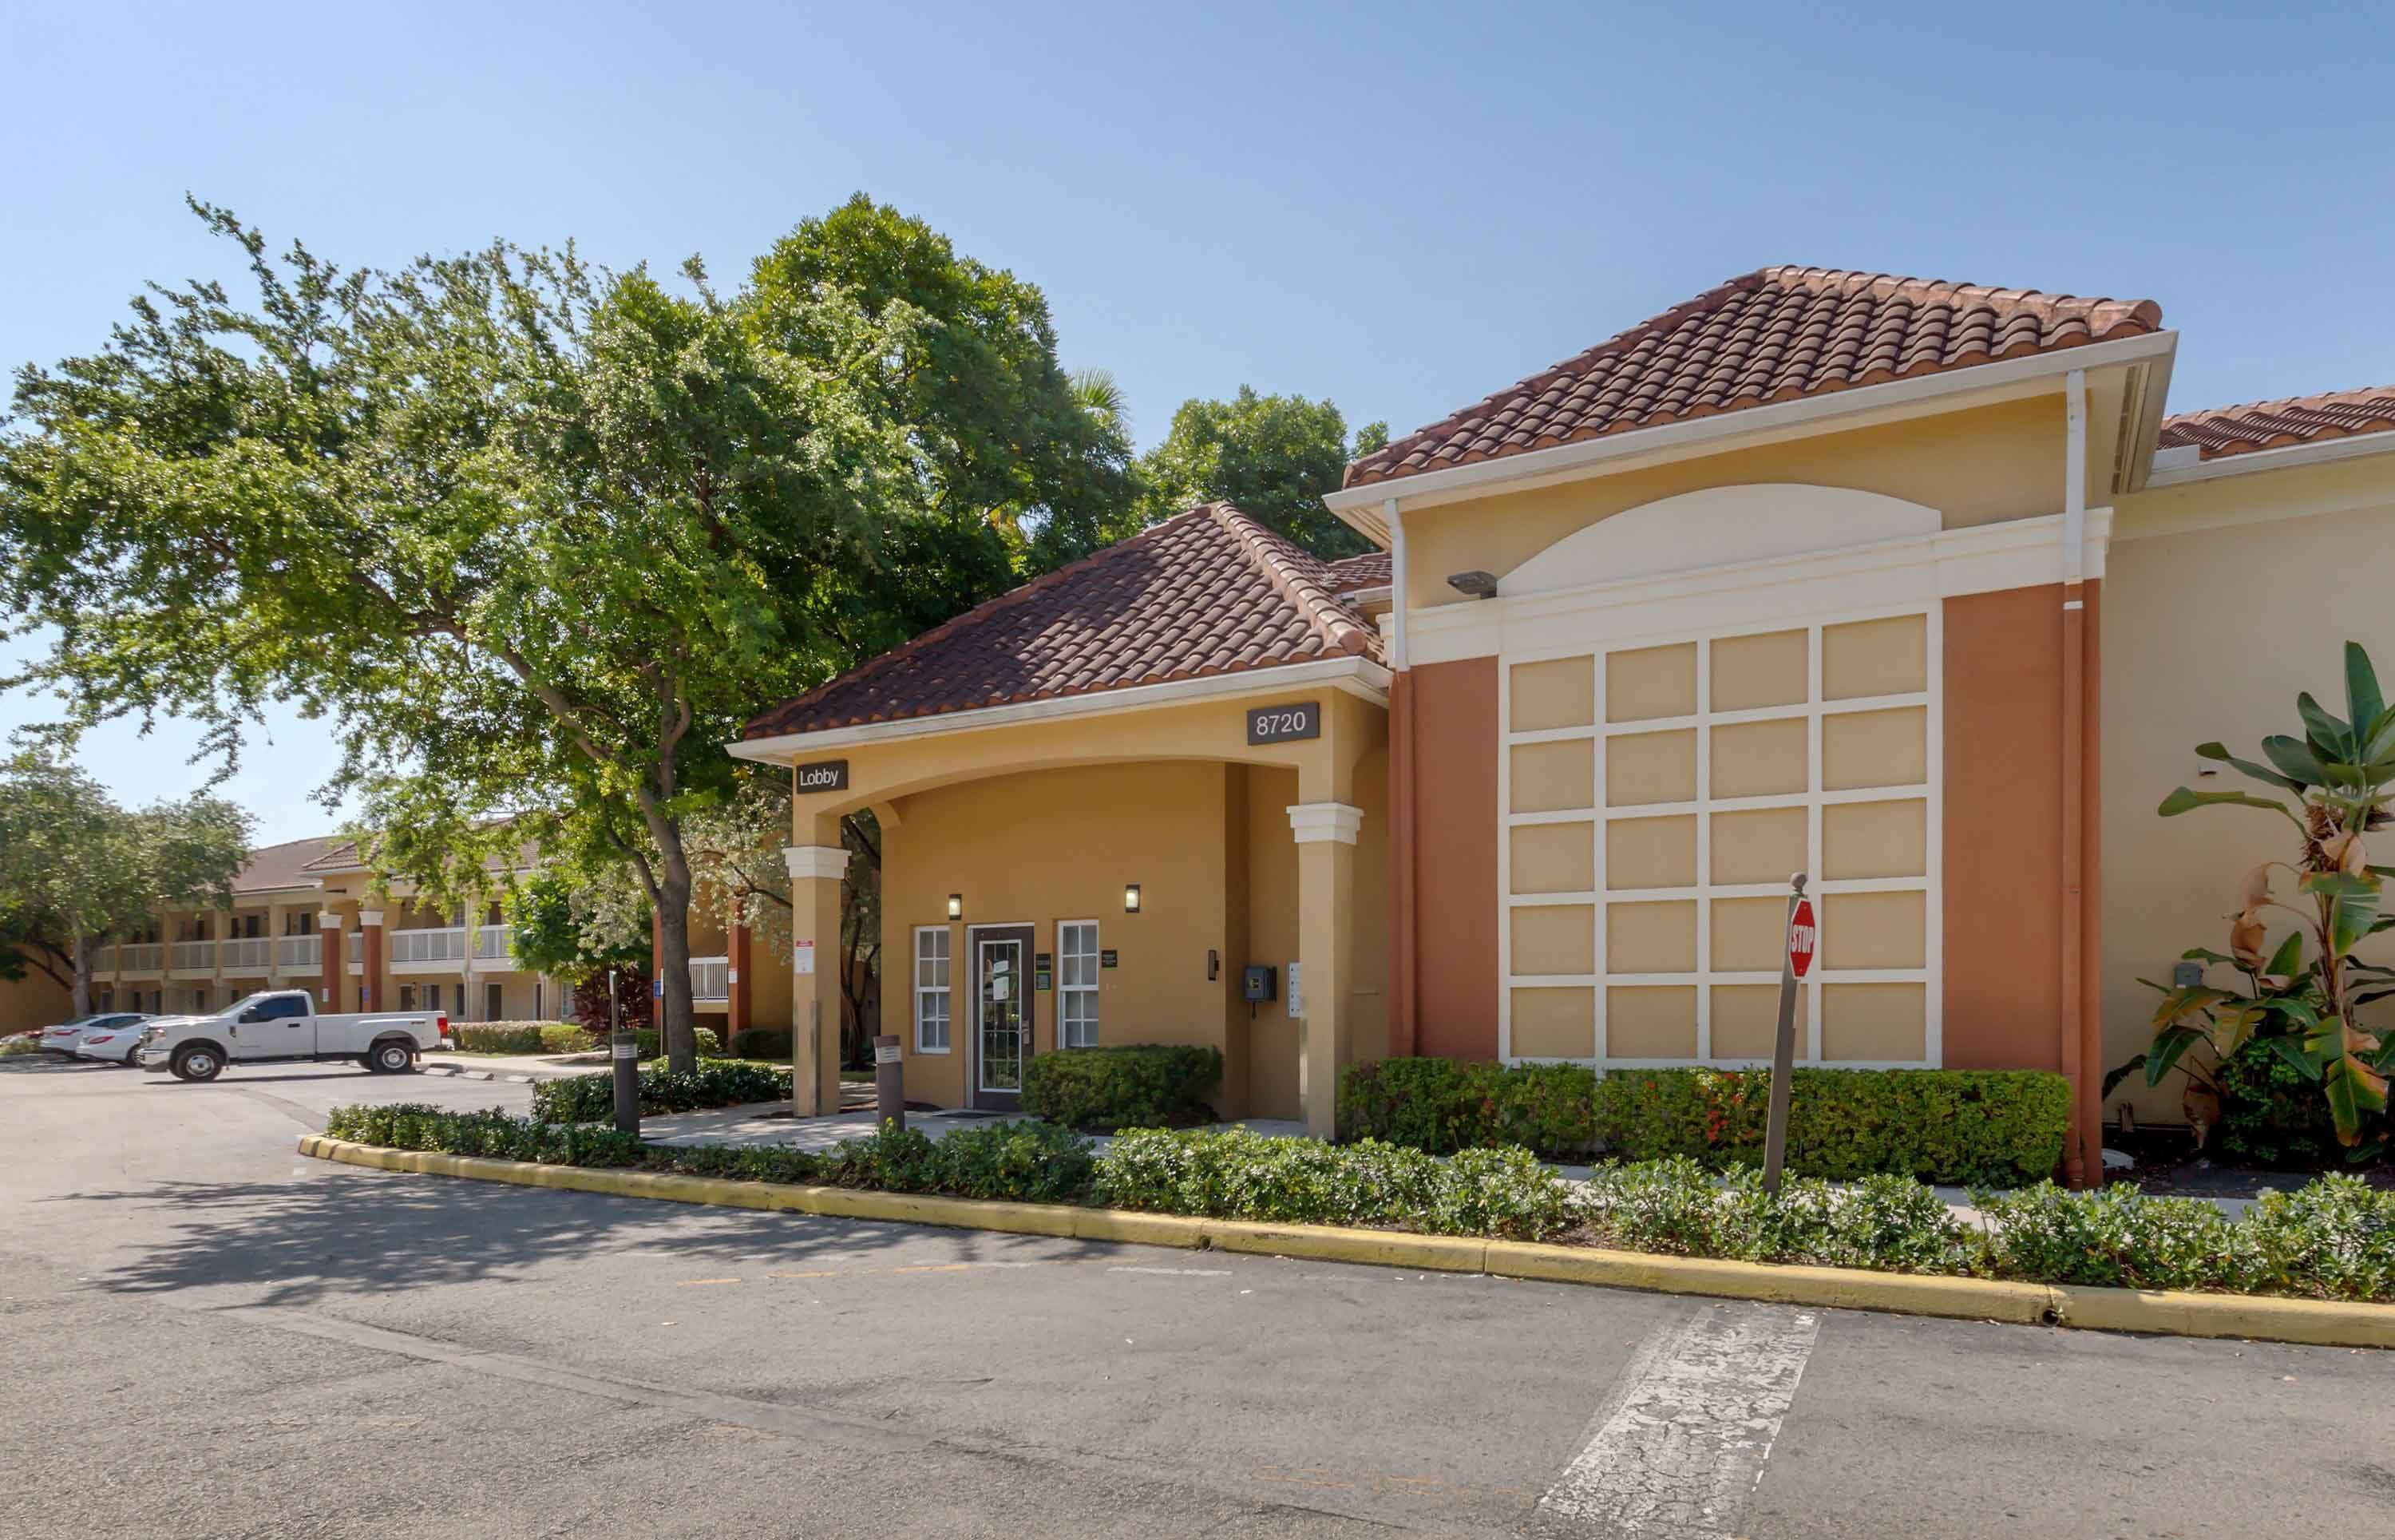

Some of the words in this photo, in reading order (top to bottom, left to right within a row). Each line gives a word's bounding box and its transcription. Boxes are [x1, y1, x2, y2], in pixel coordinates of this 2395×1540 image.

[1256, 711, 1306, 735] 8720
[800, 768, 838, 786] Lobby
[1791, 924, 1814, 953] STOP
